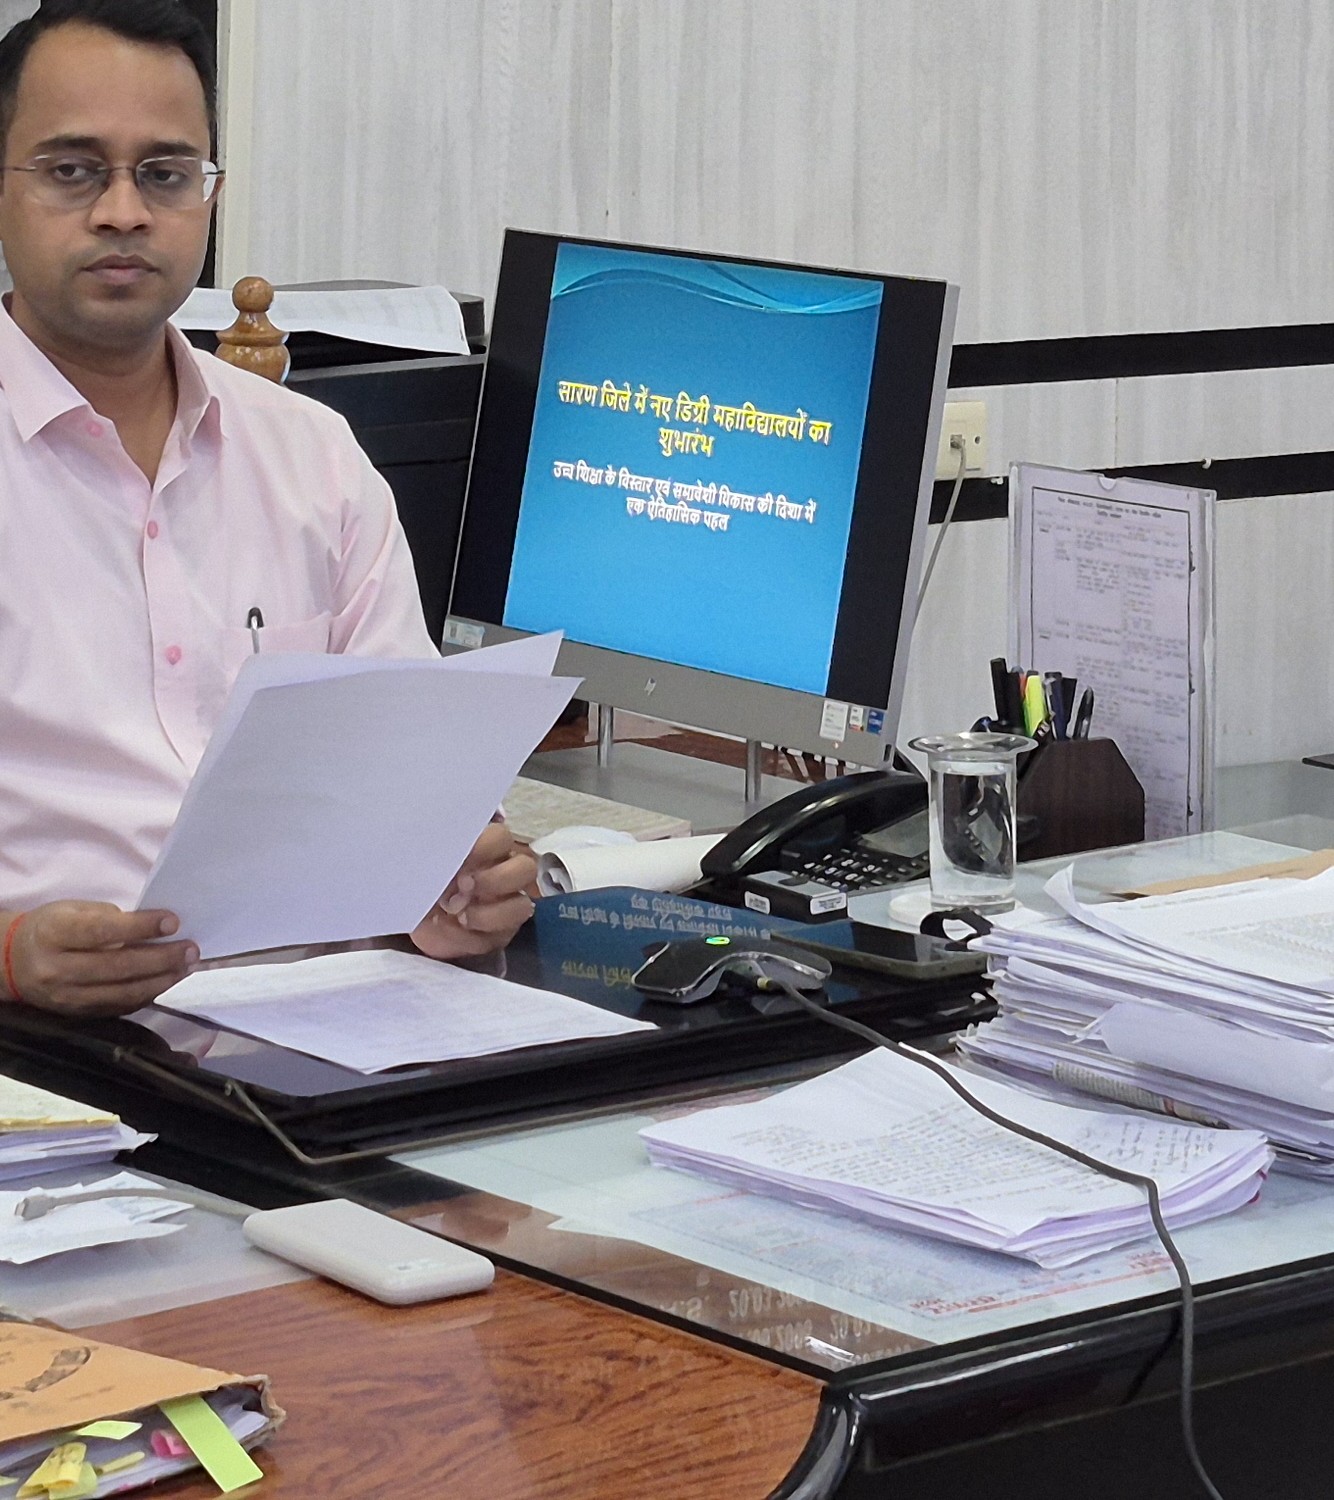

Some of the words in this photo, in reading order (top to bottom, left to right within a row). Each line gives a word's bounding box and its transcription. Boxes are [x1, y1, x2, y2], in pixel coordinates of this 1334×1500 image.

[559, 381, 598, 407] सारण
[600, 379, 632, 412] जिले
[634, 384, 649, 414] में
[650, 394, 674, 422] नए
[675, 391, 710, 425] डिग्री
[713, 401, 808, 441] महाविद्यालयों
[809, 419, 833, 446] का
[658, 427, 715, 458] शुभारंभ
[605, 464, 617, 487] के
[804, 498, 818, 524] में
[626, 496, 645, 516] एक
[703, 510, 731, 532] पहल
